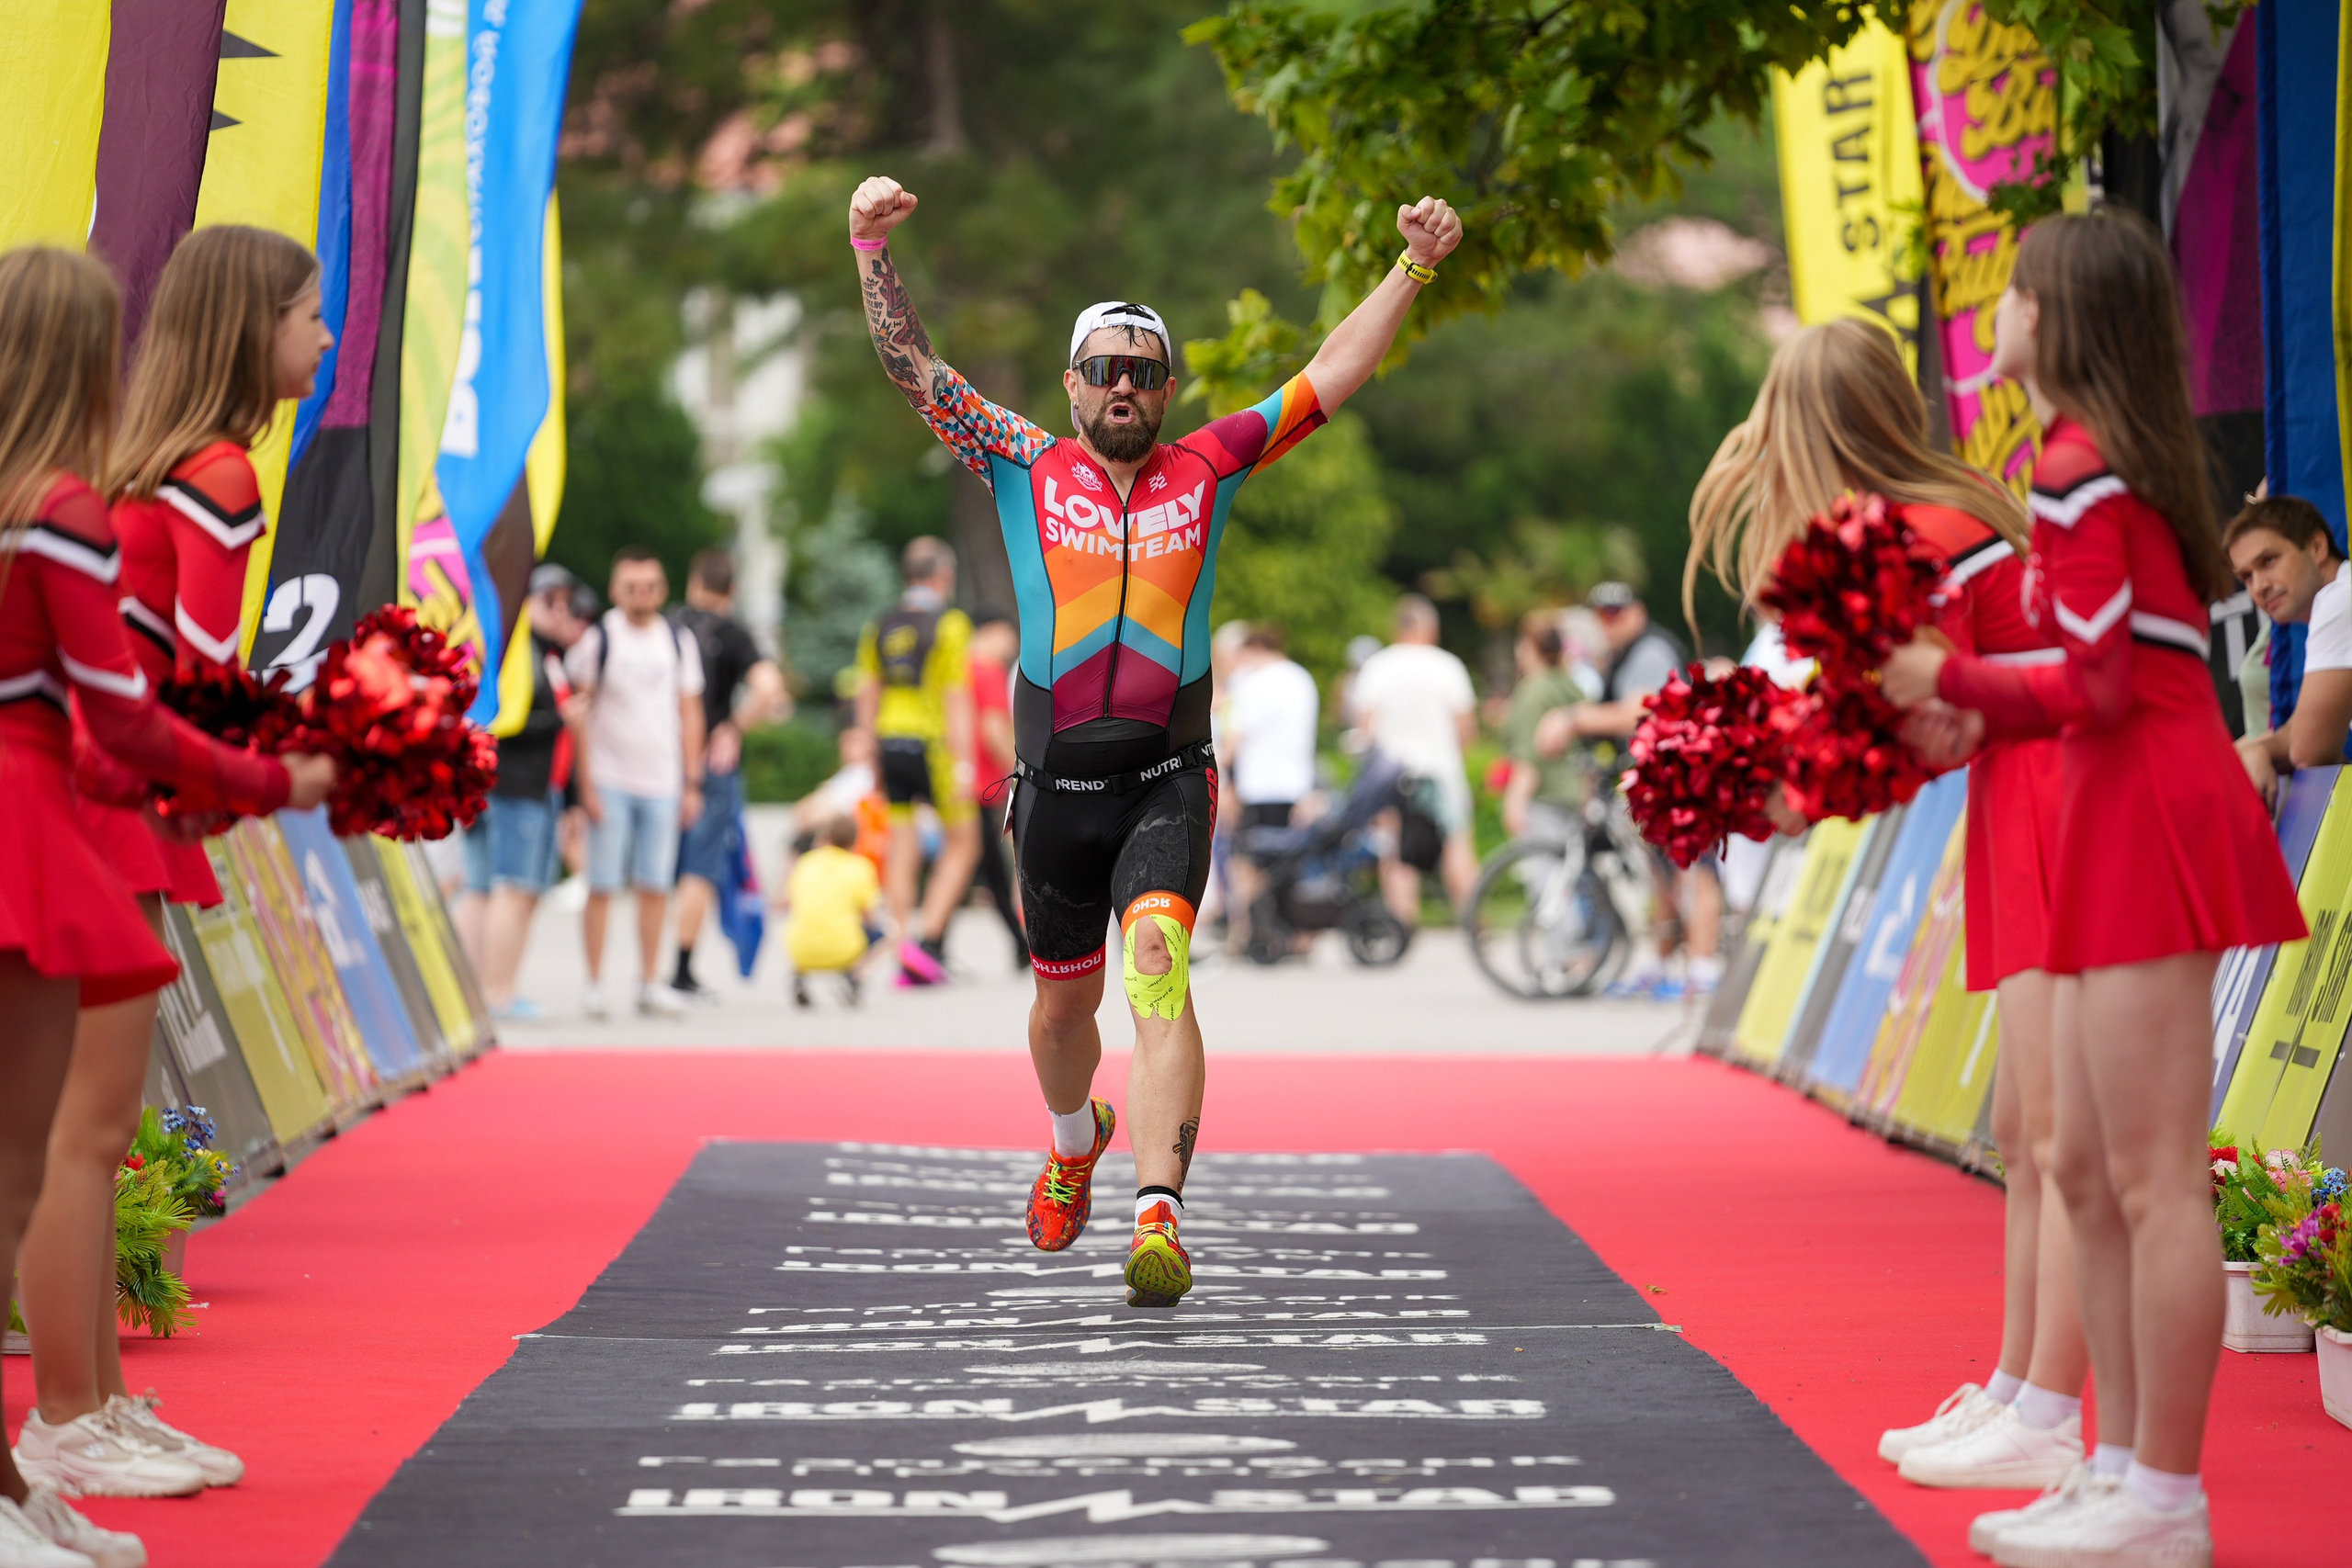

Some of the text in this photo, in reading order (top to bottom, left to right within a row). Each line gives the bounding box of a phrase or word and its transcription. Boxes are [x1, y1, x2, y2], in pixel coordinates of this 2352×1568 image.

[1822, 73, 1881, 253] STAR
[1044, 476, 1205, 539] LOVELY
[1140, 755, 1182, 782] NUTR
[738, 1317, 1020, 1332] IRON
[1174, 1334, 1487, 1344] STAR
[682, 1397, 1545, 1415] IRON STAR
[627, 1488, 1008, 1508] IRON
